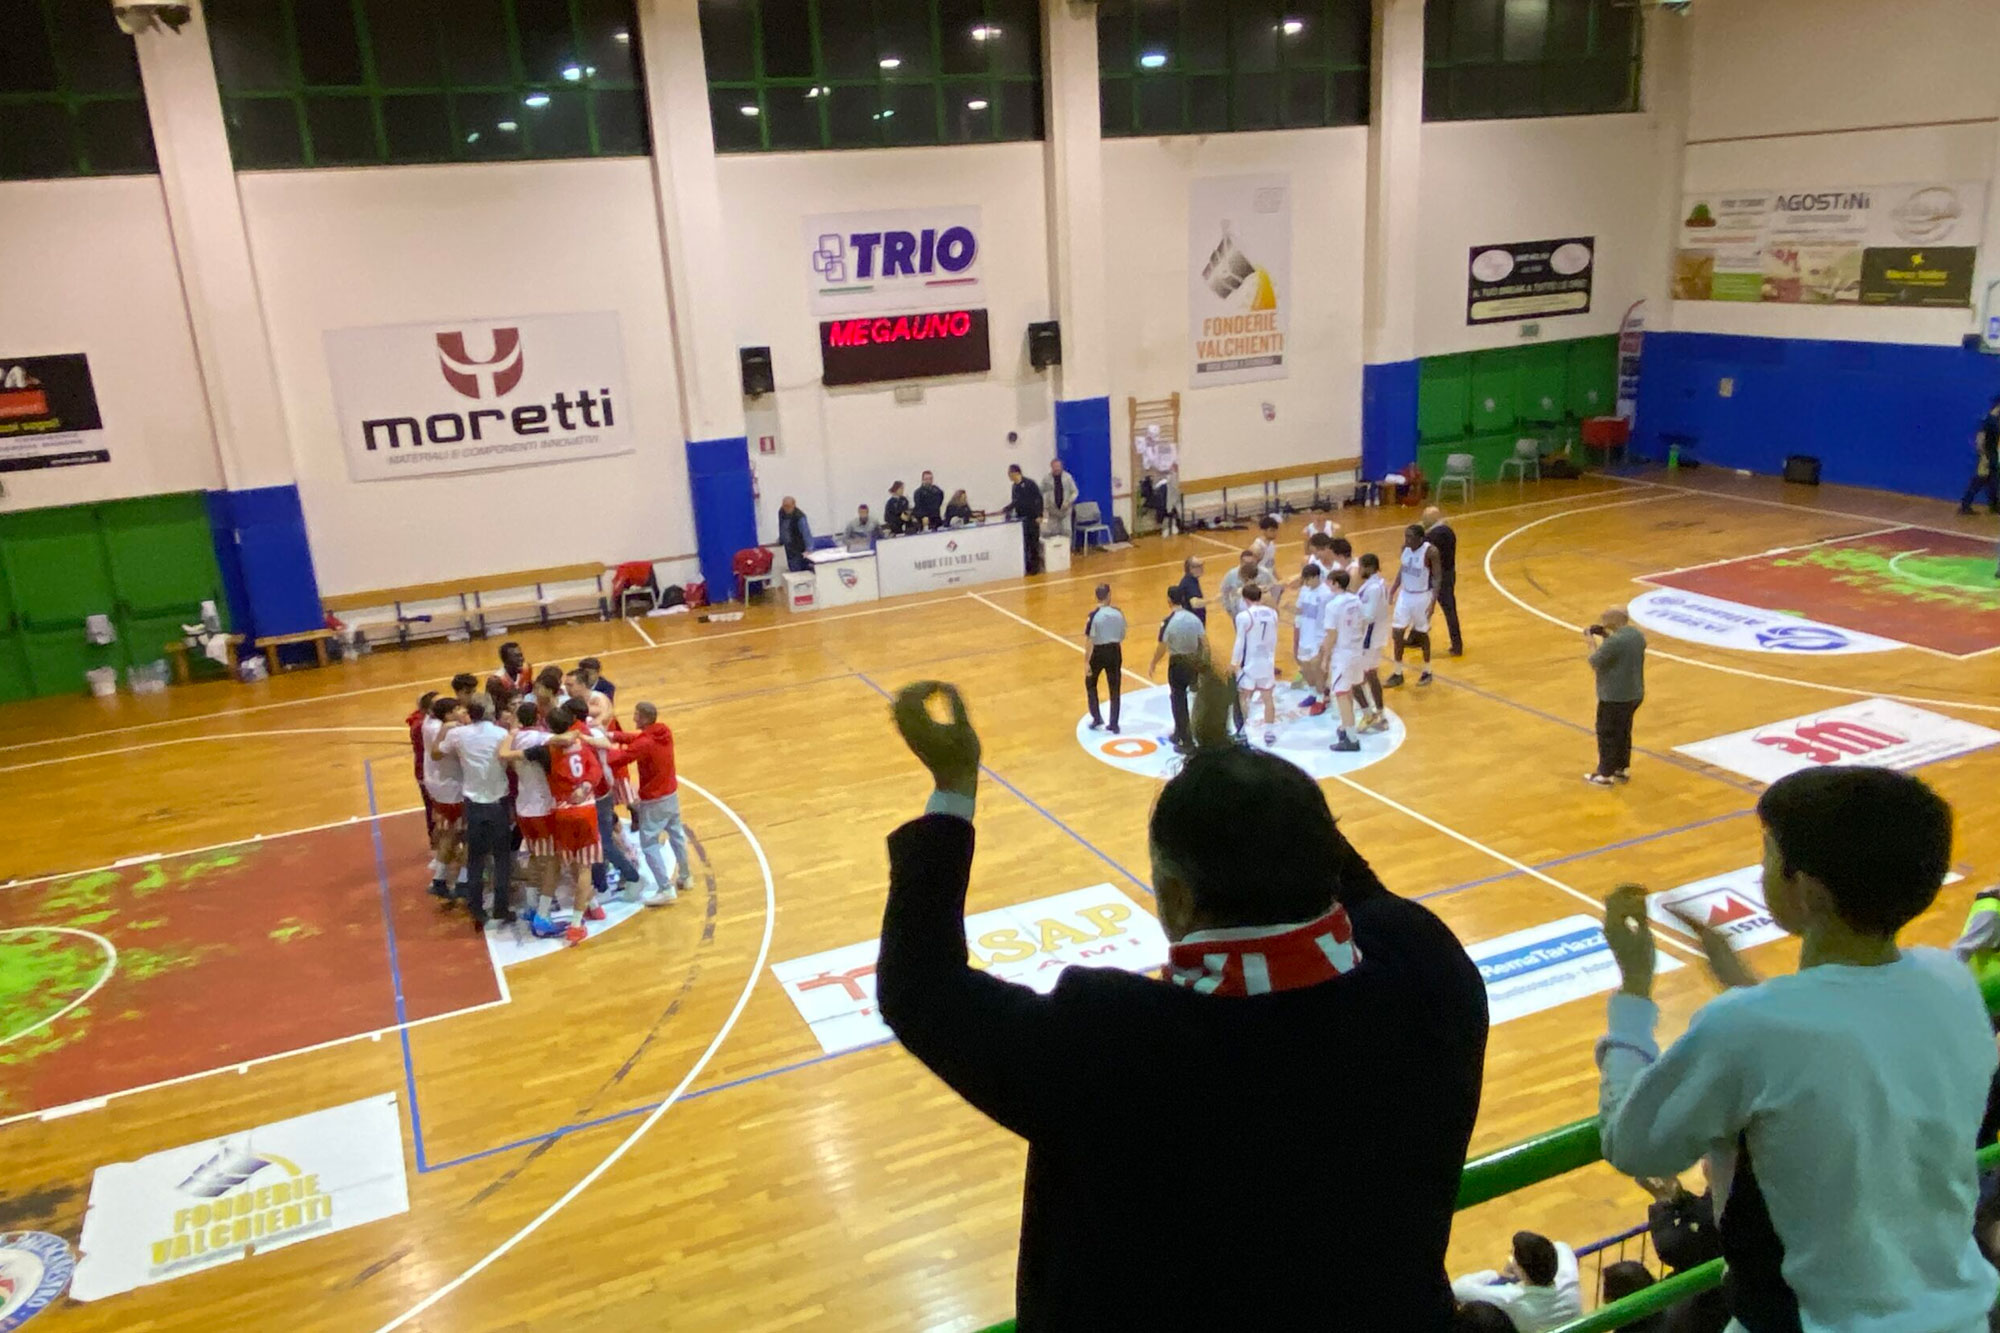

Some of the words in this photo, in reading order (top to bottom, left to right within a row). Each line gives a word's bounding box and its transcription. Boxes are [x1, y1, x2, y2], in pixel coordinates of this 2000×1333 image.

[850, 226, 976, 278] TRIO
[829, 310, 970, 347] MEGAUNO
[1203, 312, 1278, 337] FONDERIE
[1196, 333, 1284, 359] VALCHIENTI
[362, 388, 614, 450] moretti
[389, 450, 449, 465] MATERIALI
[462, 442, 538, 459] COMPONENTI
[1260, 621, 1268, 641] 7
[569, 754, 583, 778] 6
[173, 1174, 321, 1233] FONDERIE
[151, 1194, 333, 1264] VALCHIENTI
